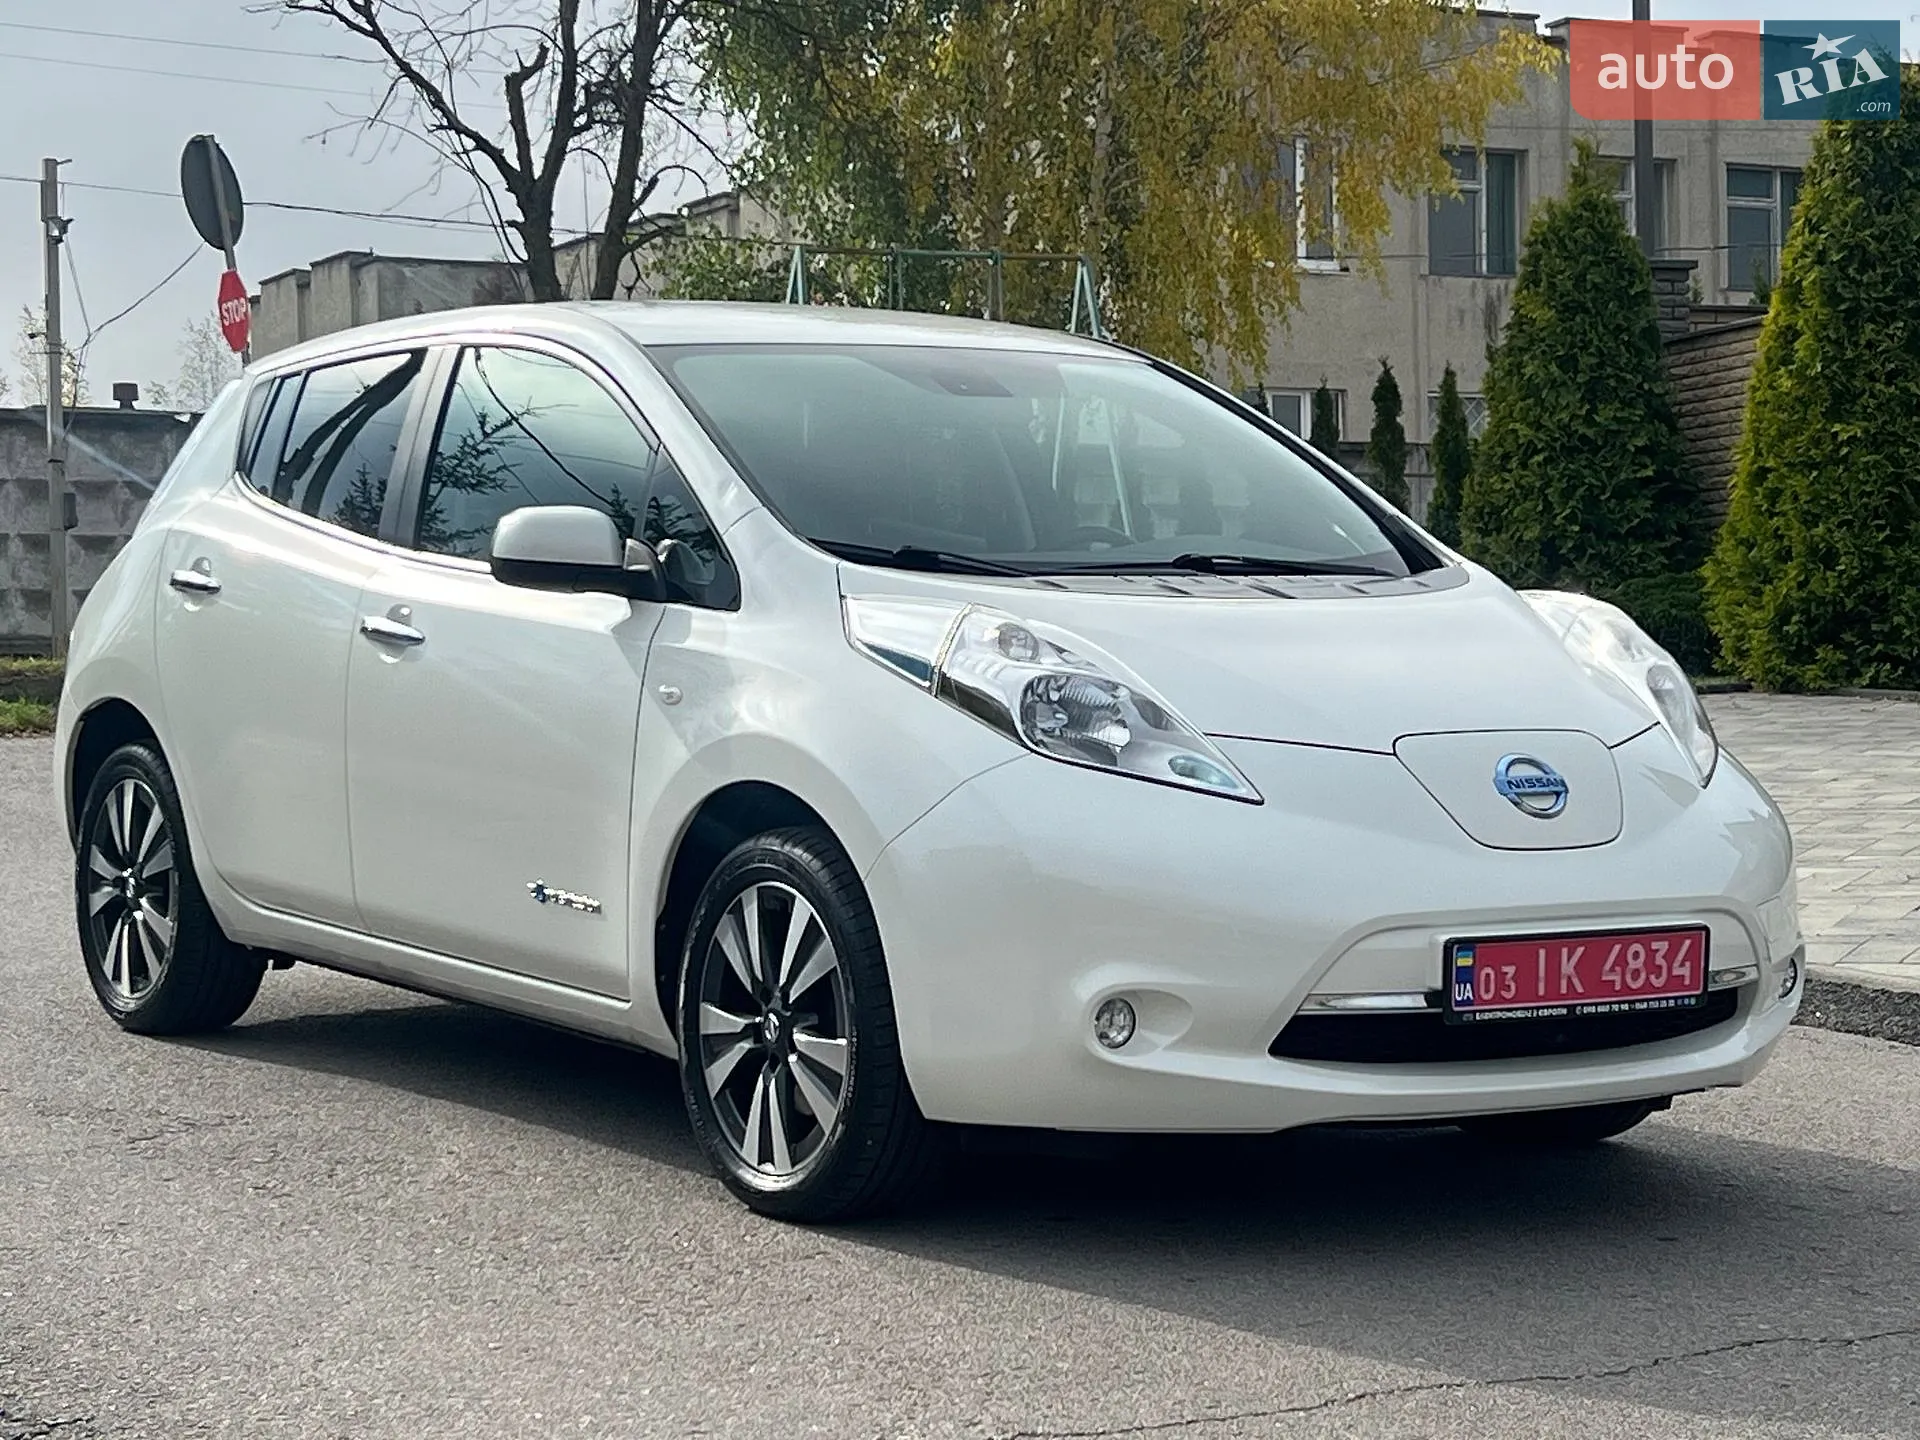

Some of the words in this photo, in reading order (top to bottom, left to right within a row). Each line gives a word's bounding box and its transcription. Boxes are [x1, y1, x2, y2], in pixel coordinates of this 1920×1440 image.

[221, 296, 247, 327] STOP
[1479, 965, 1517, 1001] 03
[1600, 939, 1692, 991] 4834
[1454, 982, 1474, 1001] UA
